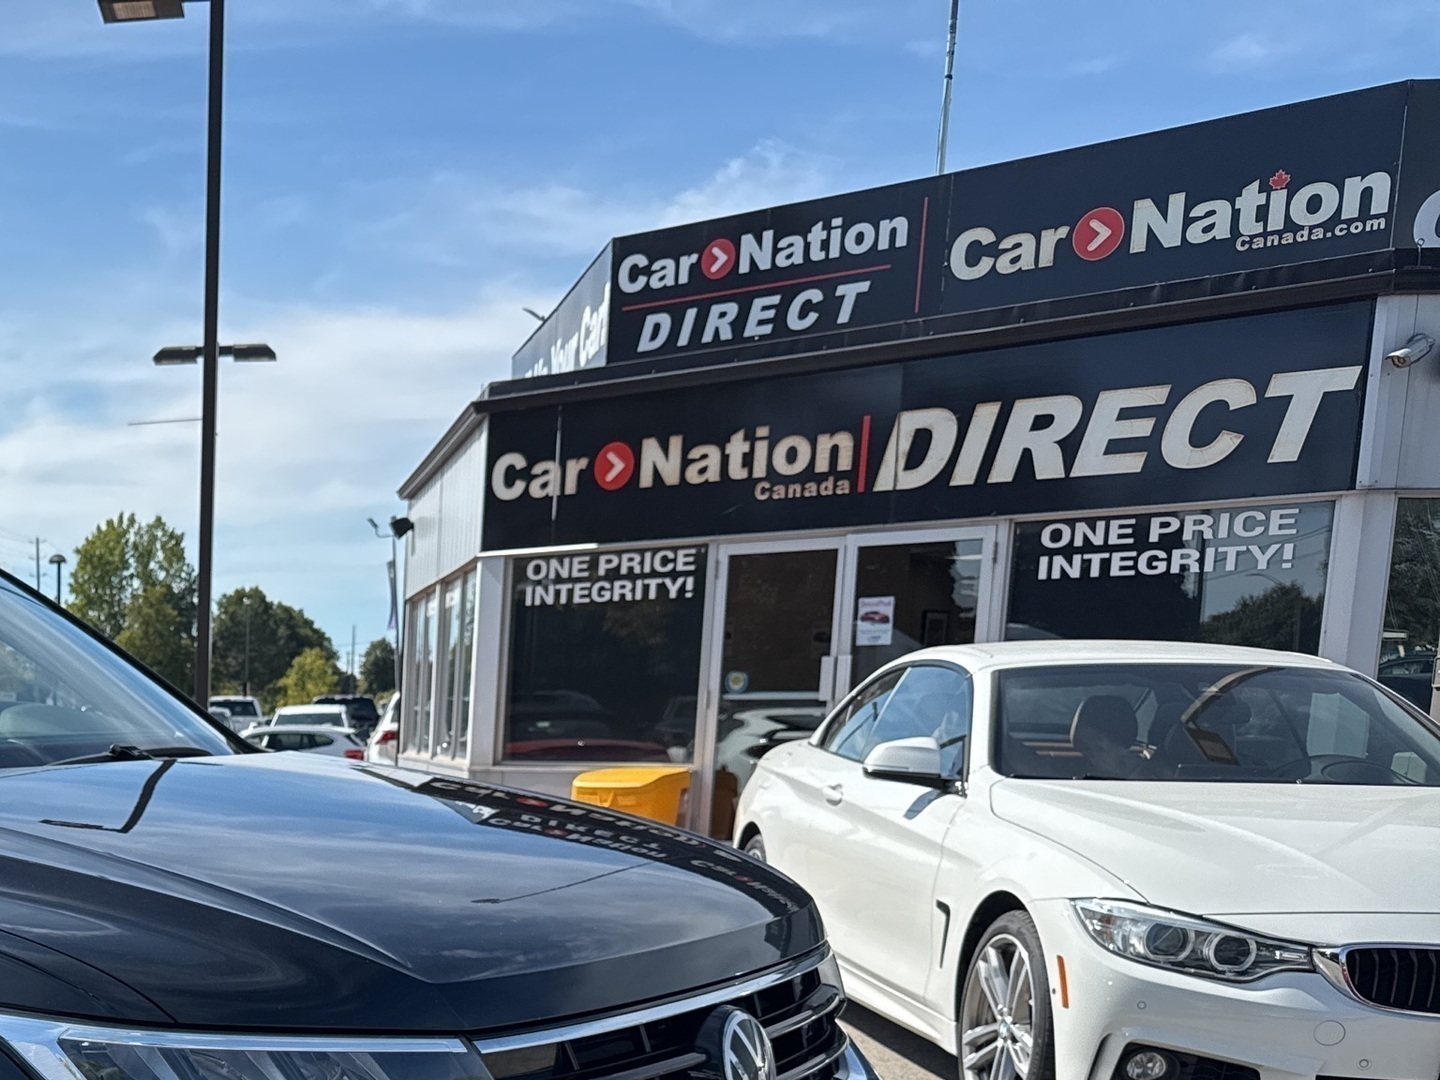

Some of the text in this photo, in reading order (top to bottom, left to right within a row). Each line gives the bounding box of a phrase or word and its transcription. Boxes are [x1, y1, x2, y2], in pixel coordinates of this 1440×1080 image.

[1235, 216, 1386, 252] Canada.com
[637, 280, 871, 352] DIRECT
[872, 365, 1363, 492] DIRECT
[754, 476, 850, 501] Canada
[1040, 508, 1300, 549] ONE PRICE
[526, 548, 697, 581] ONE PRICE
[1037, 543, 1295, 580] INTEGRITY!
[524, 576, 695, 607] INTEGRITY!
